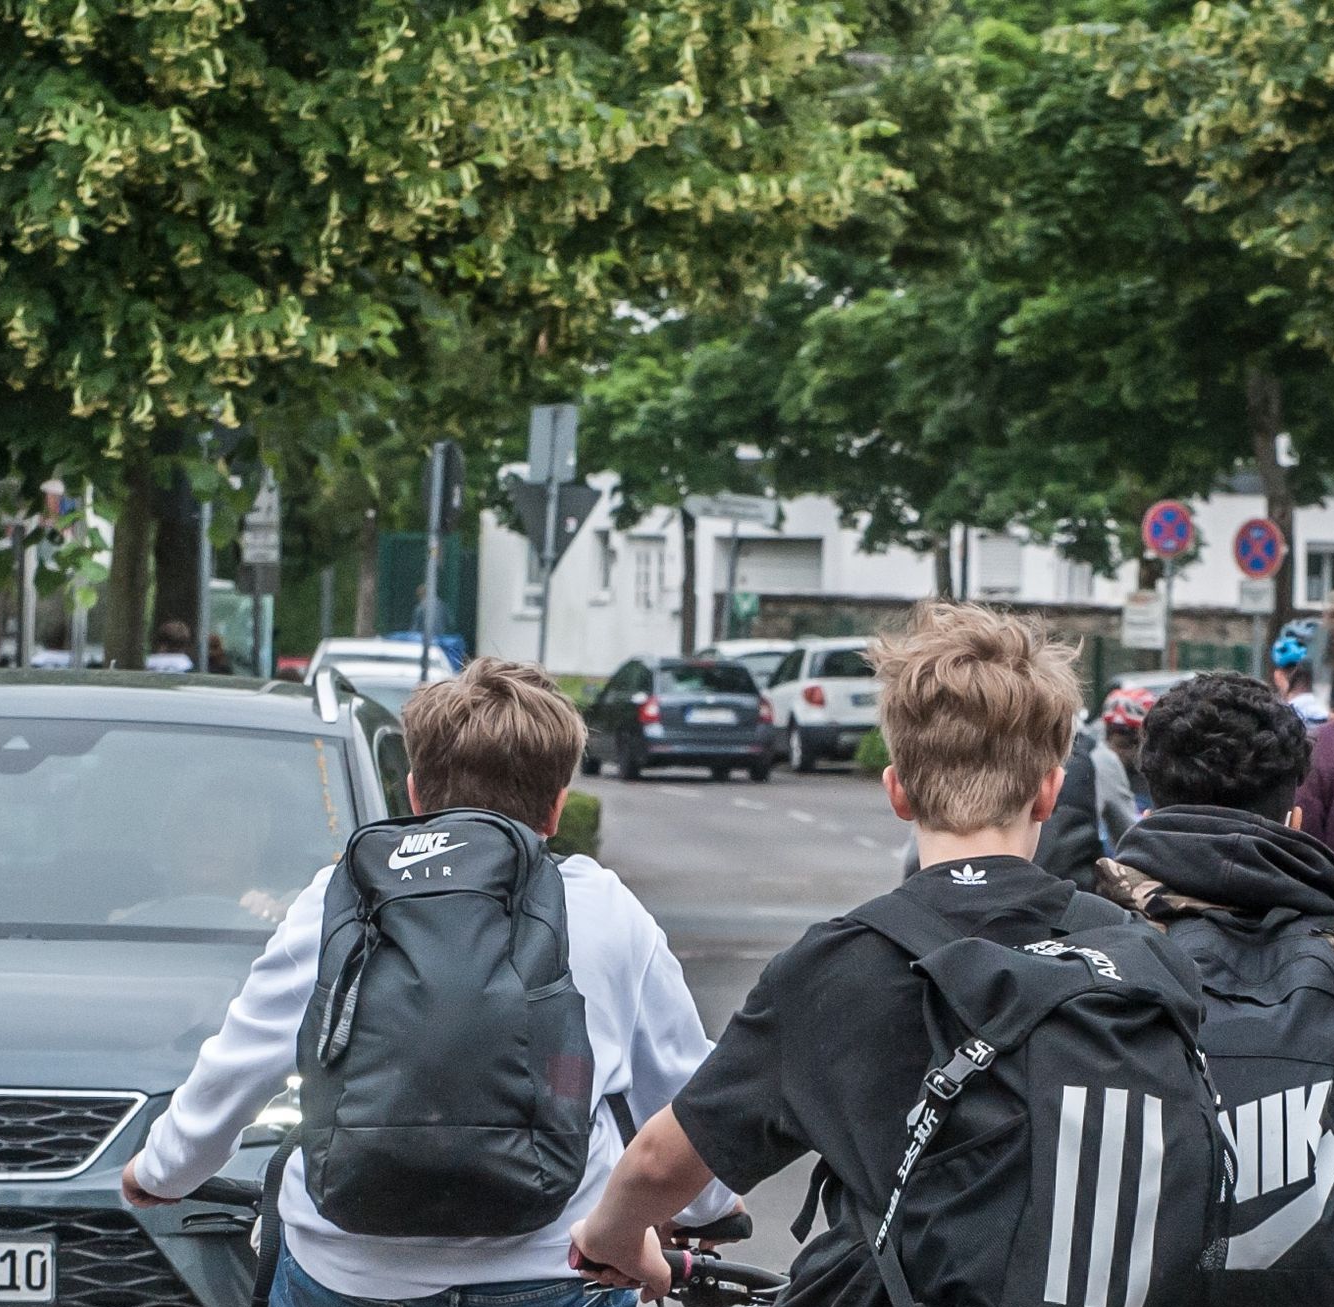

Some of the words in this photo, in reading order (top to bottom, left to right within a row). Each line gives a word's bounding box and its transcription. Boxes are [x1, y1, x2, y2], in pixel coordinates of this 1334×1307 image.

[398, 832, 450, 854] NIKE
[400, 866, 452, 881] AIR
[334, 1019, 352, 1046] NIKE
[1218, 1079, 1334, 1204] NIK
